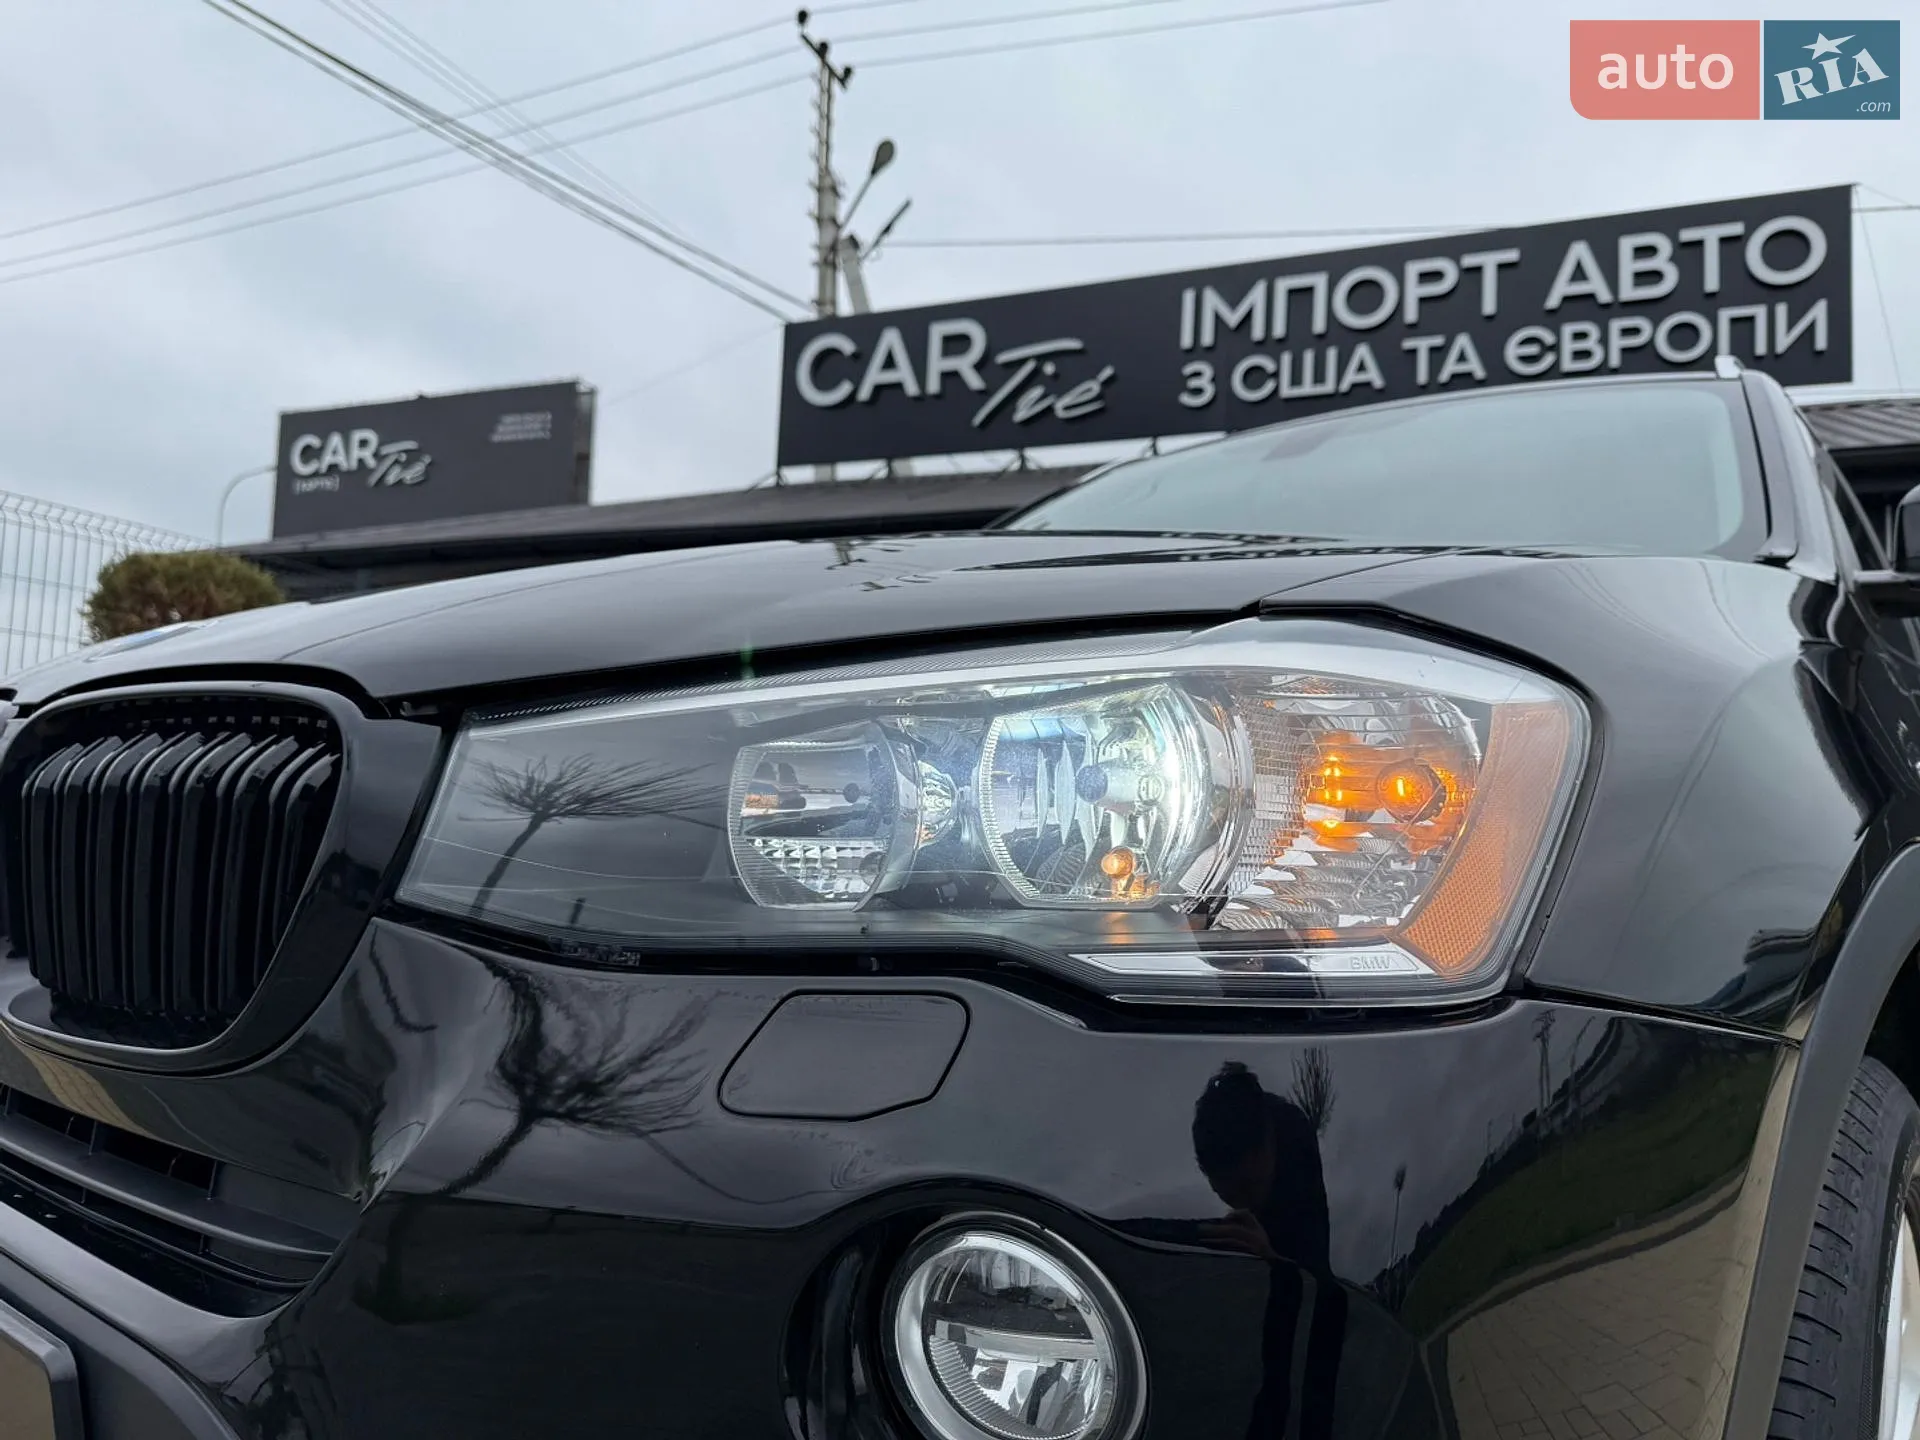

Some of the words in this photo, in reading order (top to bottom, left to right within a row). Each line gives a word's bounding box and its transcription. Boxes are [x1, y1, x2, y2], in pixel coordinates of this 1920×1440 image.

[1179, 248, 1520, 351] ІМПОРТ
[1543, 215, 1828, 312] АВТО
[795, 317, 988, 408] CAR
[1230, 341, 1386, 403] США
[1401, 331, 1488, 387] ТА
[1503, 298, 1828, 377] ЄВРОПИ
[290, 428, 380, 477] CAR
[1349, 955, 1391, 971] BMW
